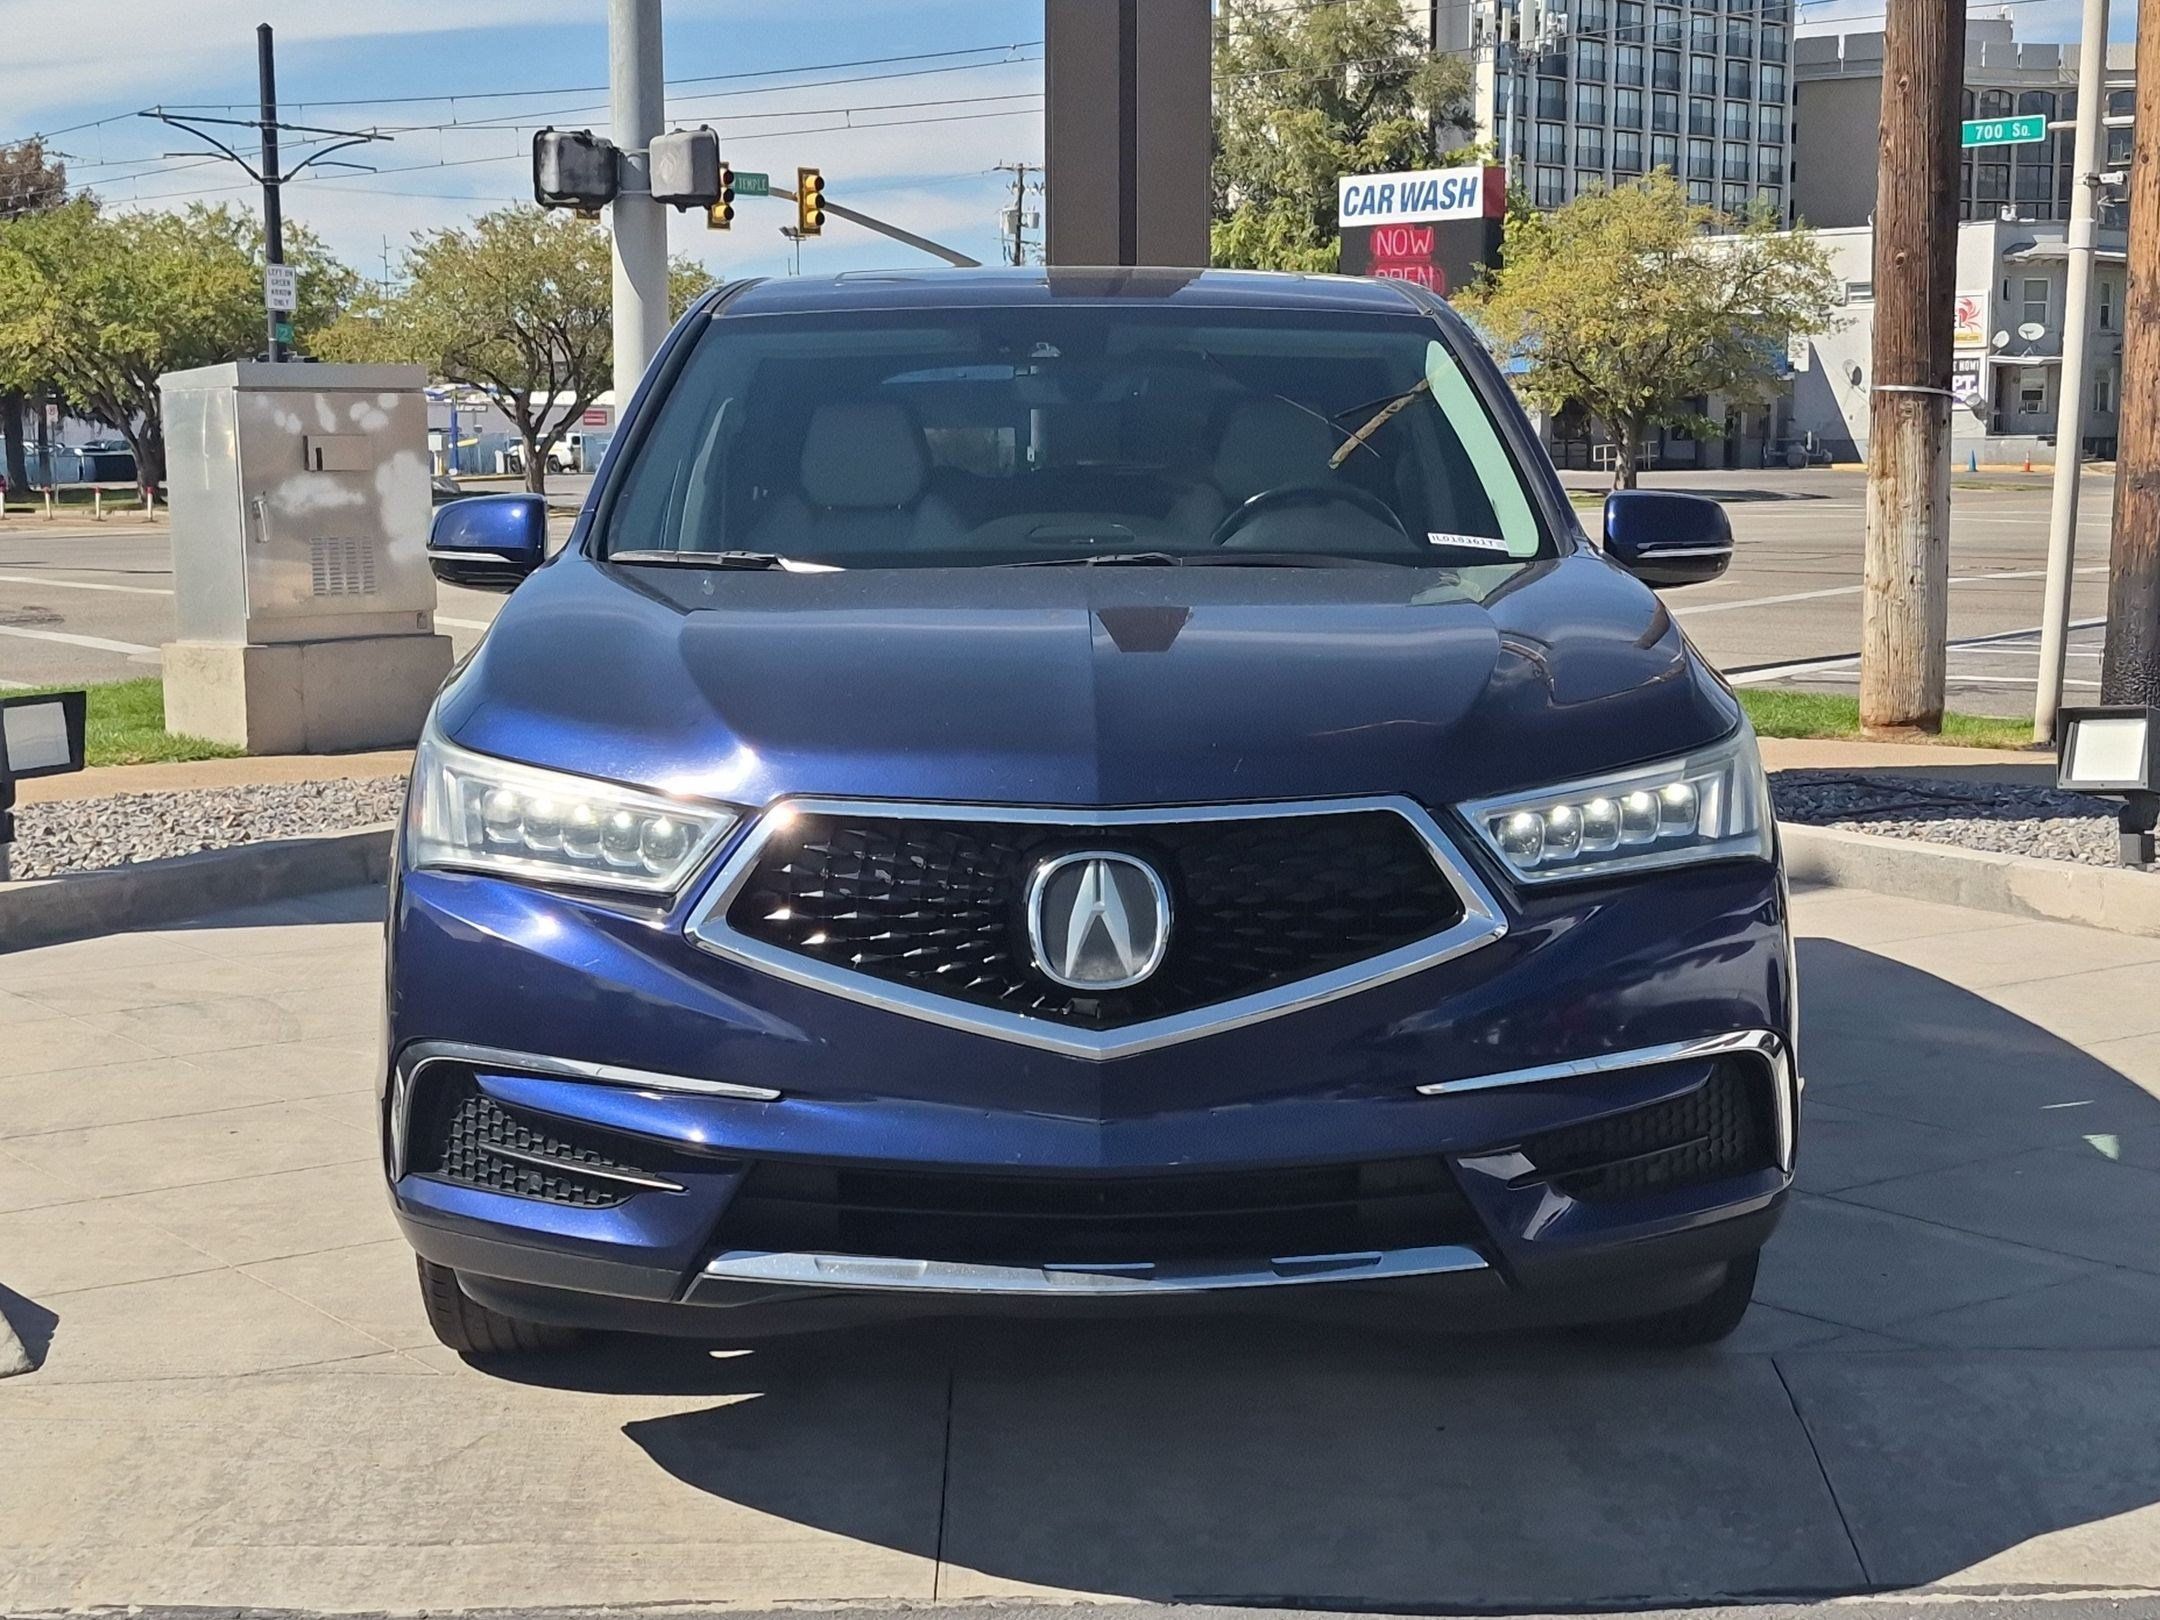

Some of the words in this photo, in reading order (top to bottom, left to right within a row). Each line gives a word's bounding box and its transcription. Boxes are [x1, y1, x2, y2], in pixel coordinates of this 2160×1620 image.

[1975, 124, 2003, 140] 700
[1343, 184, 1395, 217] CAR
[1400, 176, 1478, 213] WASH
[1376, 226, 1432, 256] NOW
[268, 268, 282, 277] LEFT
[271, 278, 290, 287] GREEN
